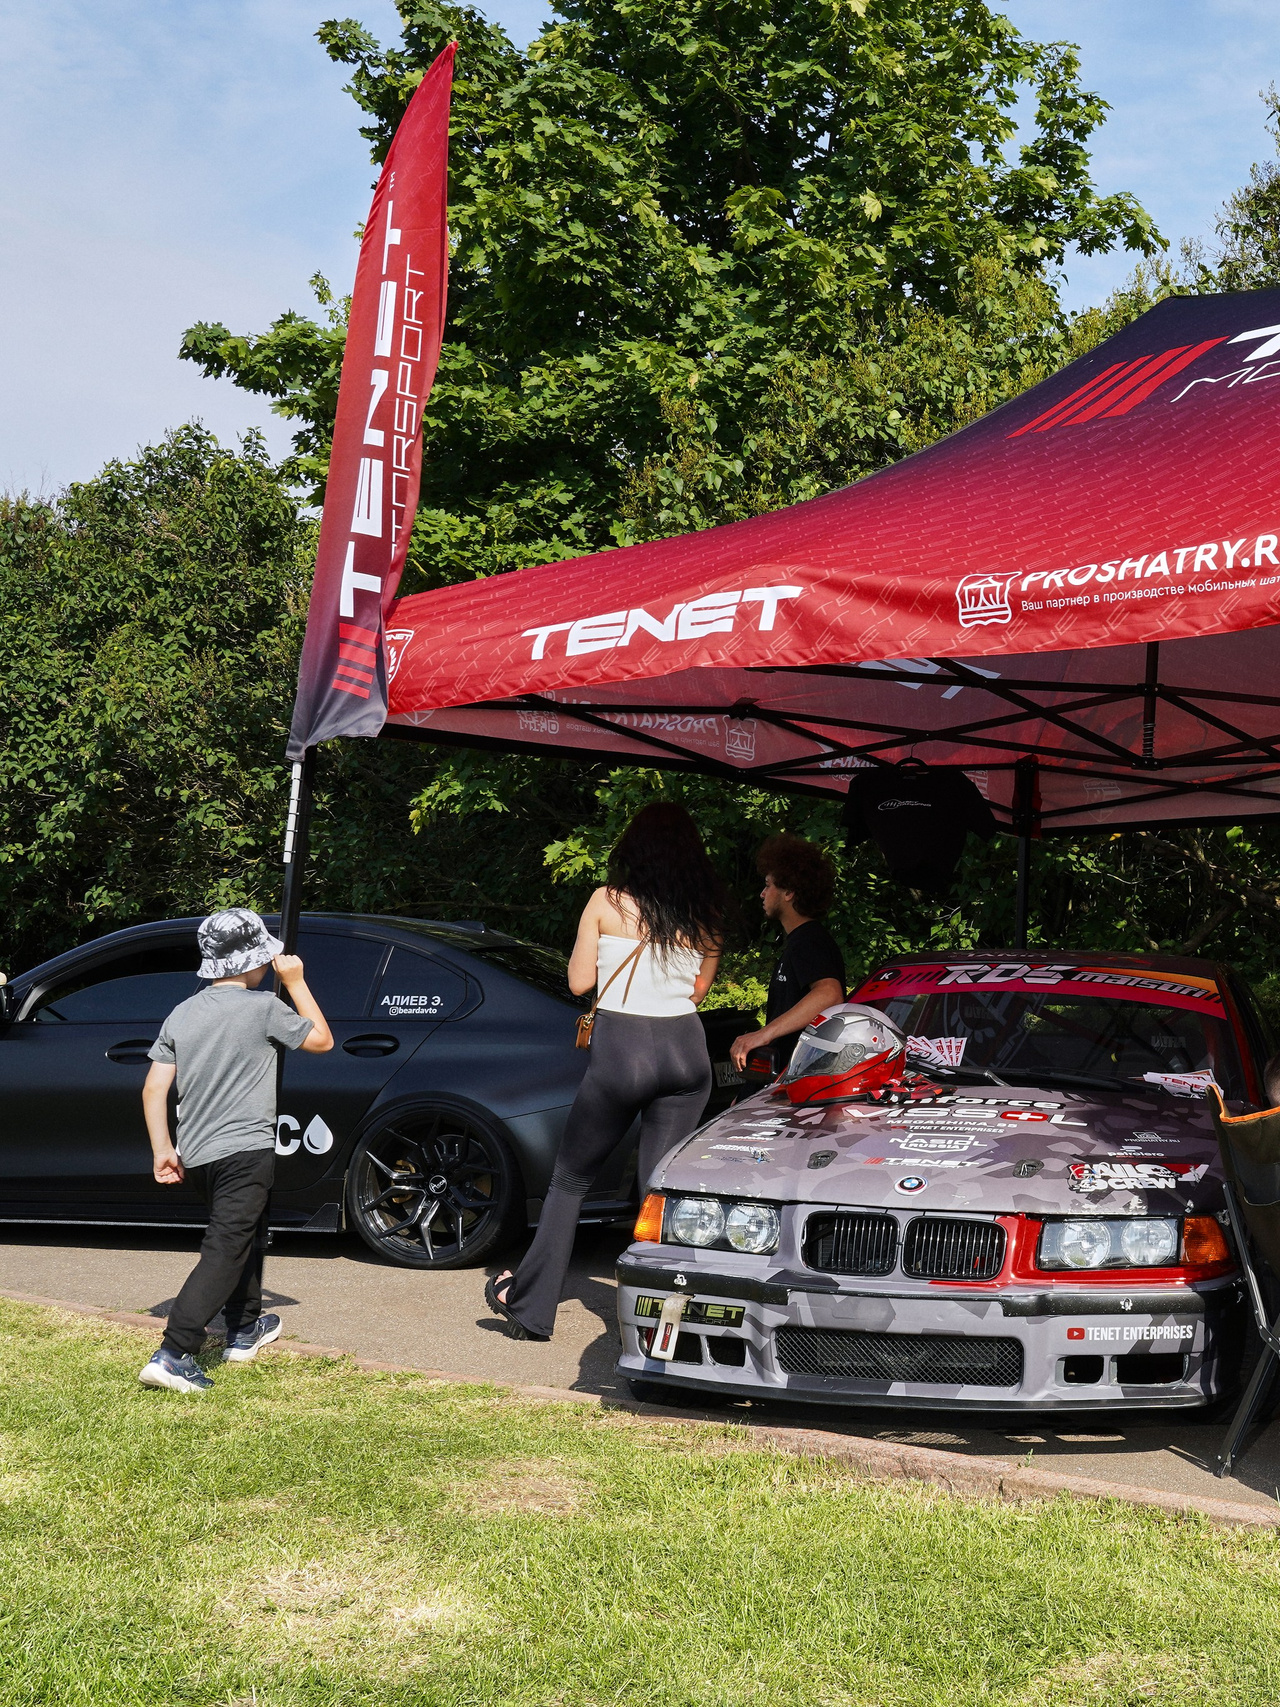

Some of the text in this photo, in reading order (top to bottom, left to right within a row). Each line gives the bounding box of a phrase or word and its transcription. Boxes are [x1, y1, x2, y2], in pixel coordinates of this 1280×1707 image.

[339, 200, 402, 618] TENET
[390, 254, 425, 561] TORSPORT
[1021, 599, 1044, 612] Ваш
[1046, 594, 1092, 611] партнер
[1094, 593, 1101, 603] в
[1103, 583, 1185, 604] производстве
[1188, 576, 1257, 594] мобильных
[522, 585, 803, 661] TENET
[938, 963, 1078, 986] RDS
[380, 995, 444, 1006] АЛИЕВ Э.
[1161, 1076, 1206, 1090] TENE
[943, 1126, 1005, 1134] ENTERPRISES
[889, 1137, 988, 1147] NASIOL
[881, 1157, 980, 1167] TENET
[1107, 1177, 1177, 1189] CREW
[653, 1298, 744, 1319] TNET
[1087, 1325, 1193, 1341] TENET ENTERPRISES
